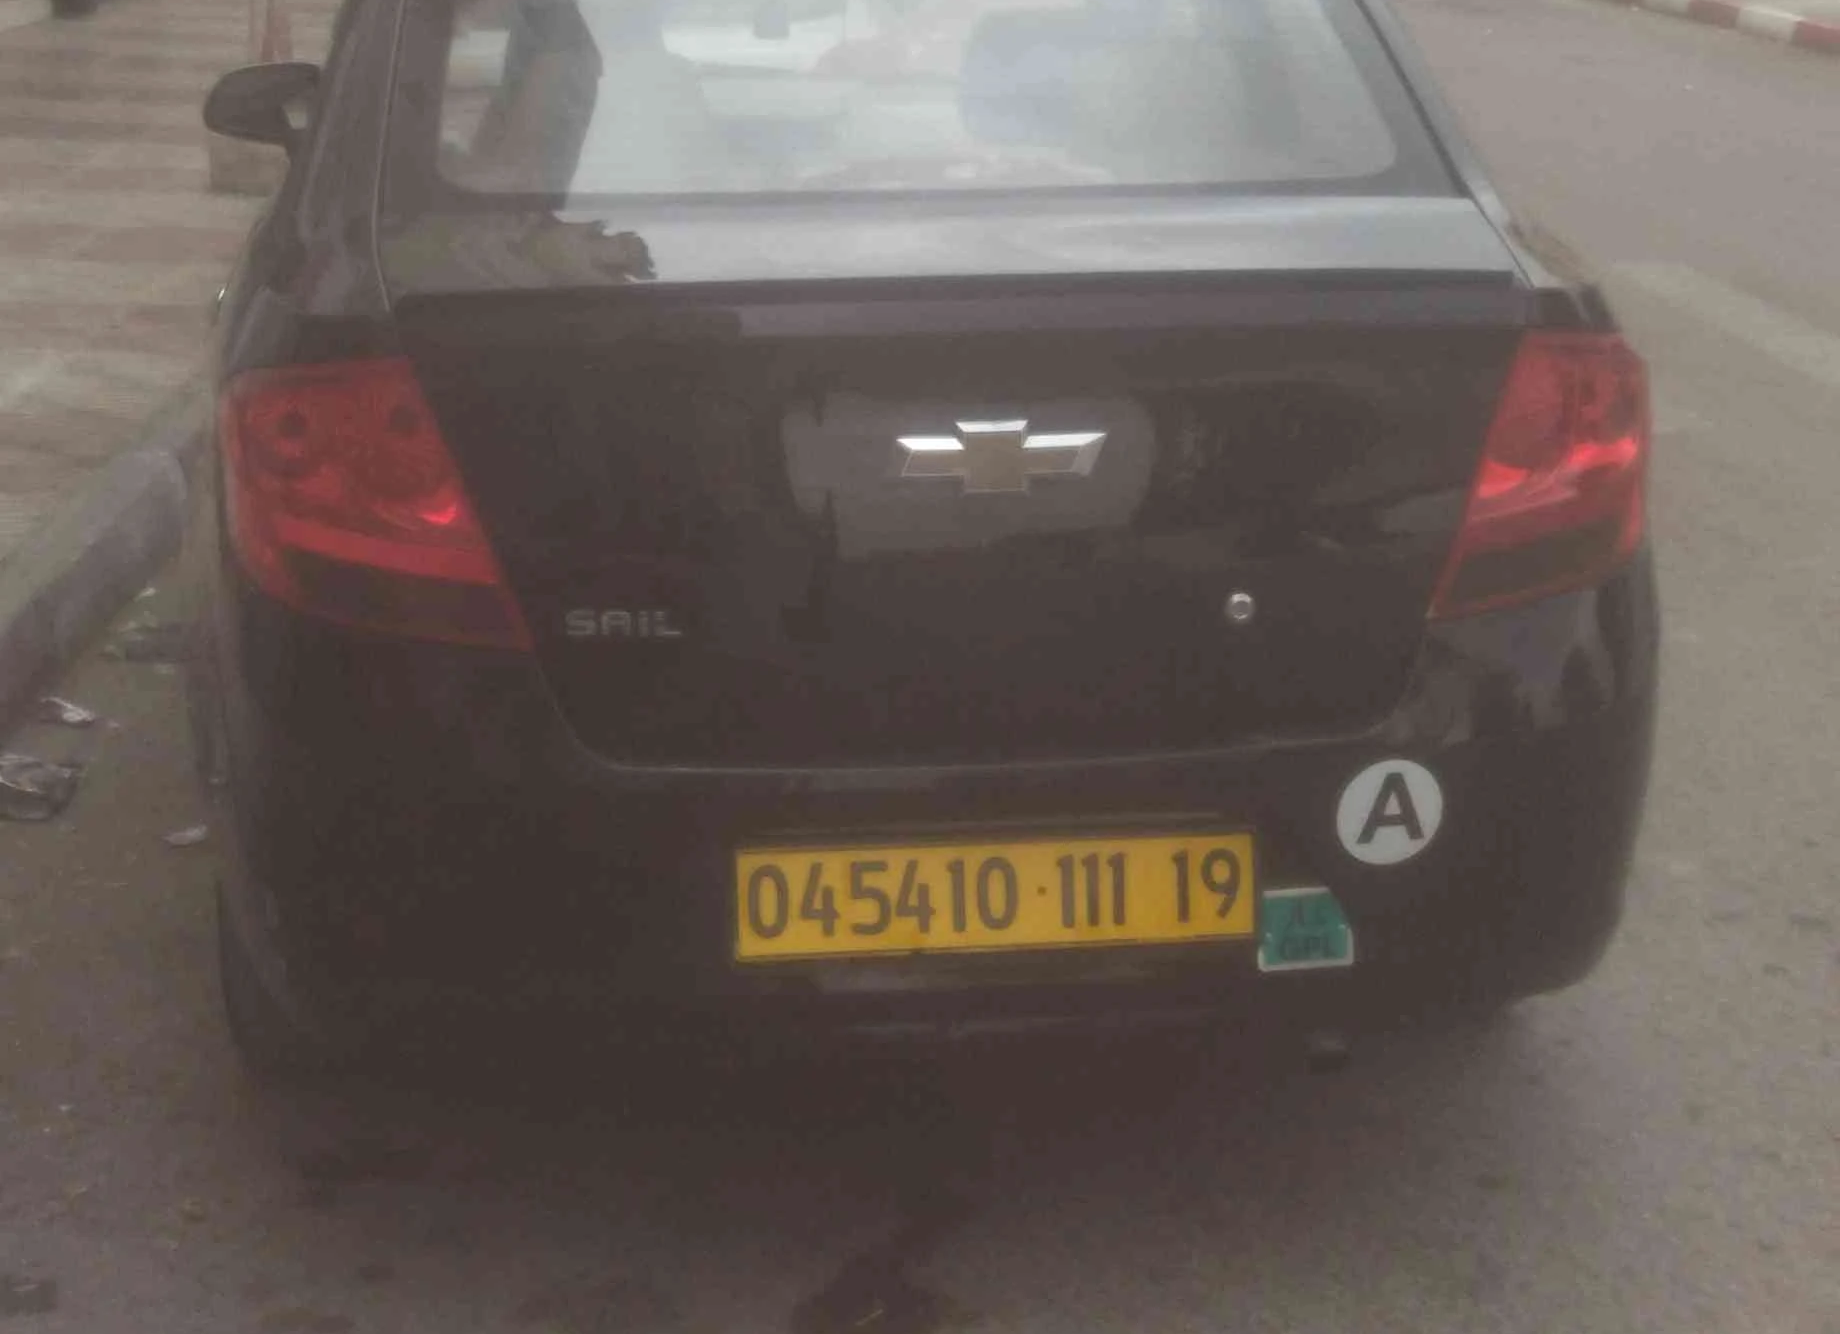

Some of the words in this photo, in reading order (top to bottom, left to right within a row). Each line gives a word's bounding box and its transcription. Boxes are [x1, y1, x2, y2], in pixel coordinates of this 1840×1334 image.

[566, 610, 682, 637] SAIL
[1356, 771, 1424, 845] A
[747, 857, 1017, 939] 045410
[1170, 848, 1241, 923] 19
